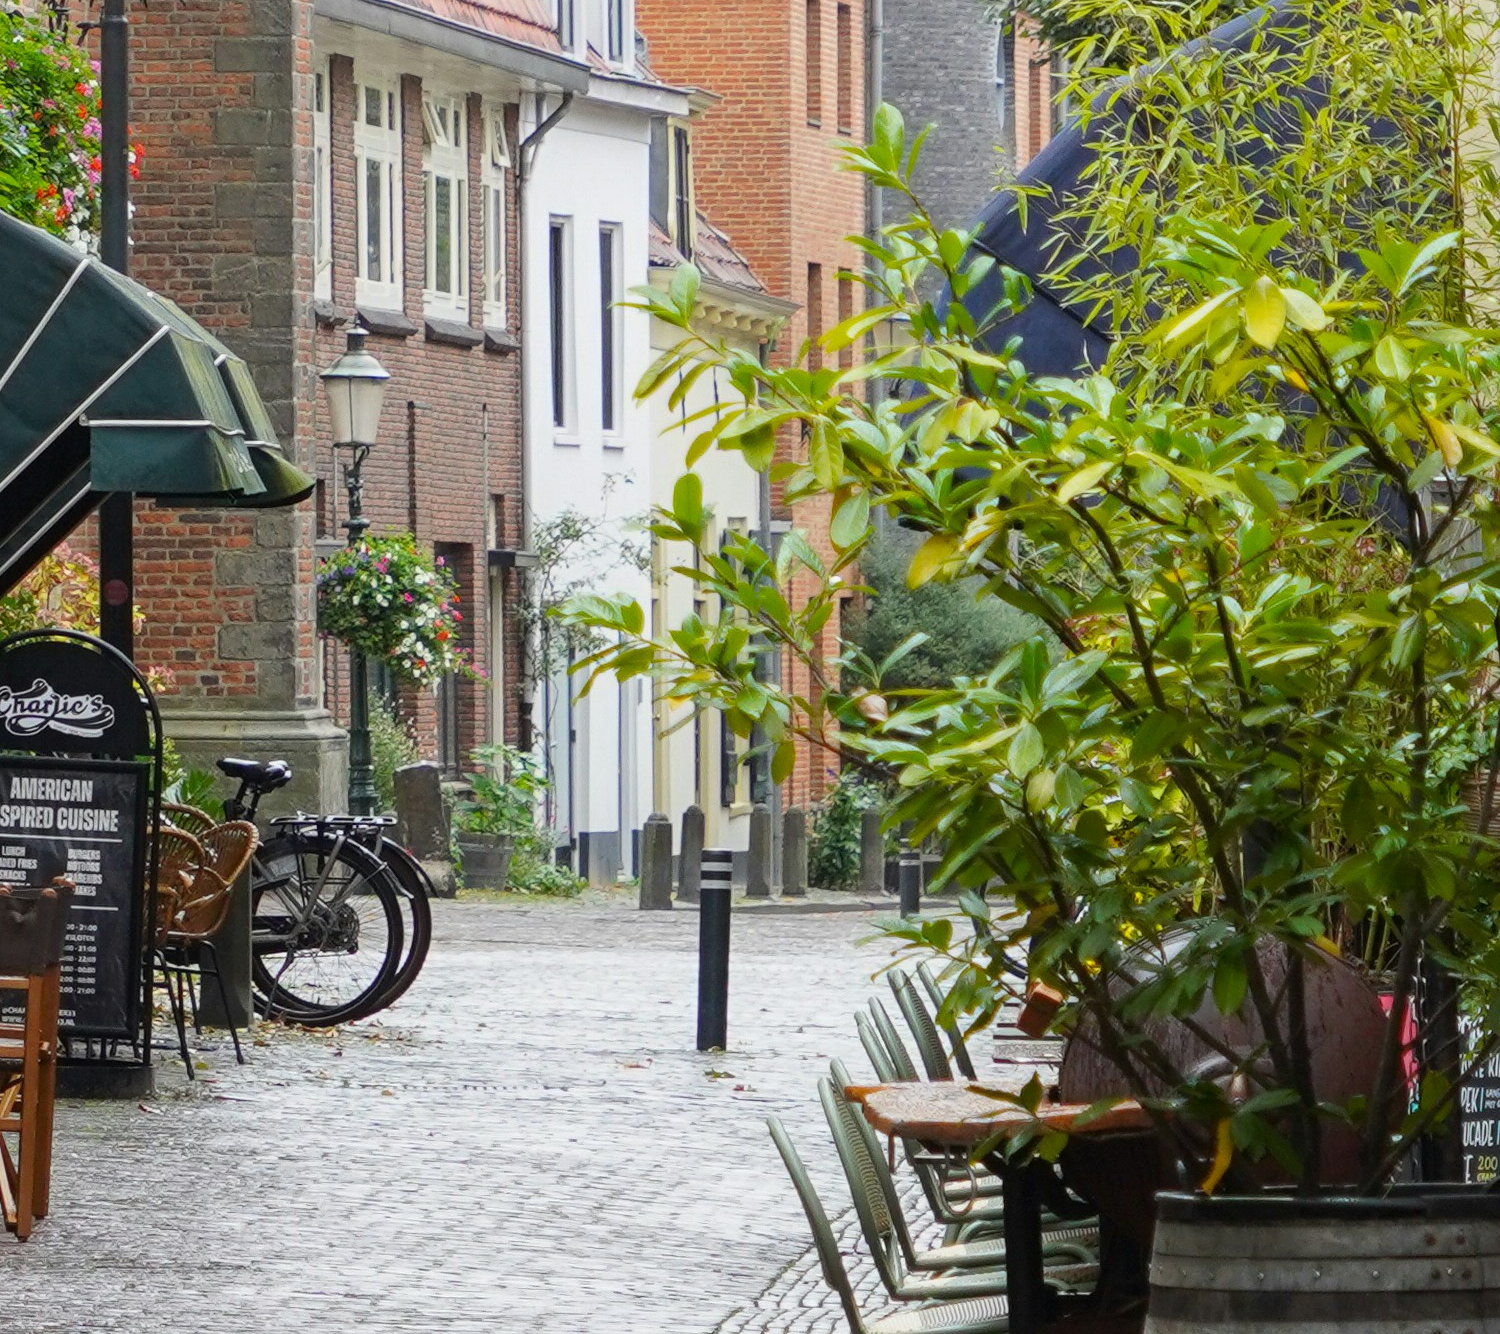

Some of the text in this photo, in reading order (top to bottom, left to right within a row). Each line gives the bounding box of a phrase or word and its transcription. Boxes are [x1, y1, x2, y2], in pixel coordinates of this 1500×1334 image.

[10, 777, 94, 803] AMERICAN
[56, 808, 120, 832] CUISINE
[1, 845, 26, 857] LUNCH
[67, 849, 101, 861] BURGERS
[17, 858, 38, 870] FRIES
[66, 861, 101, 873] HOTDOGS
[1460, 1086, 1480, 1114] PEK
[1461, 1119, 1496, 1148] UCADE
[1477, 1155, 1498, 1172] 200
